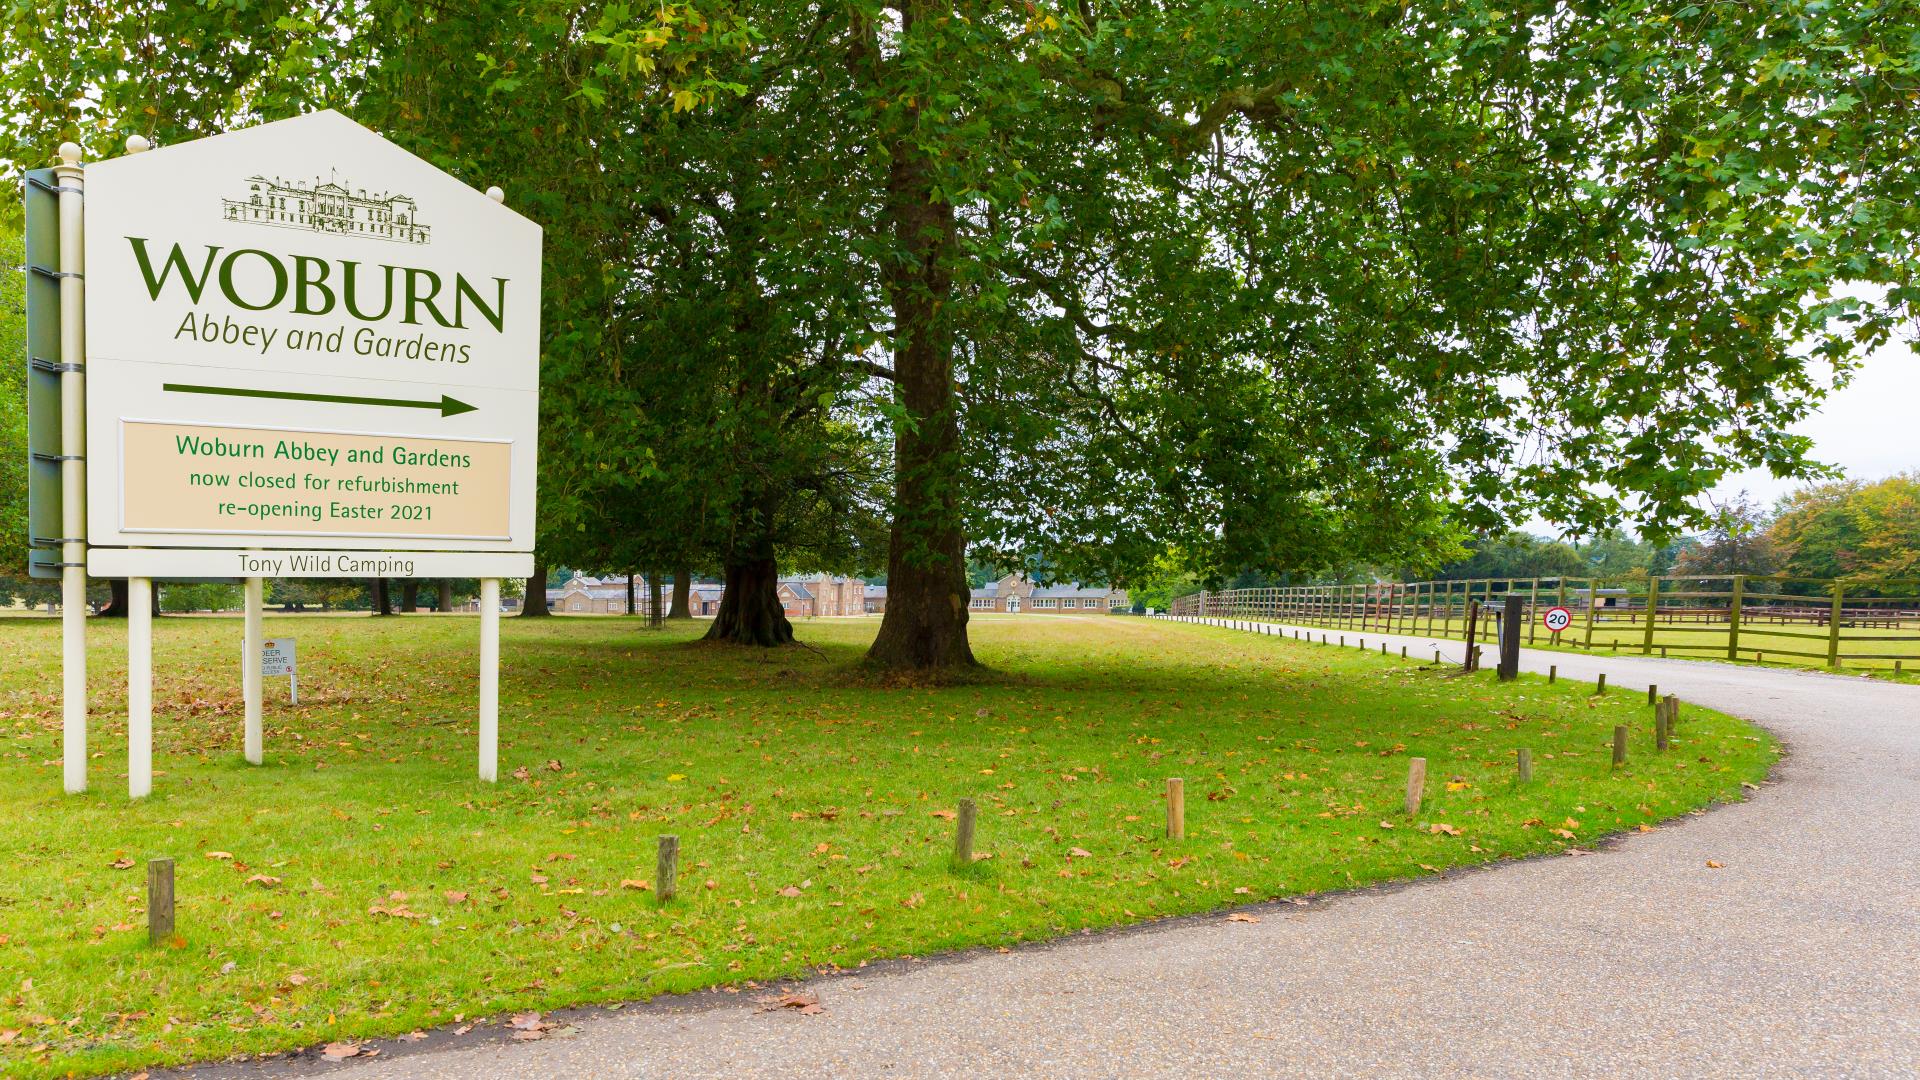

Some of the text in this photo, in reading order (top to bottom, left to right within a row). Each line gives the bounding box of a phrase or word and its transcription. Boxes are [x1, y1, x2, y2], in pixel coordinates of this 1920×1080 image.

[124, 237, 510, 334] WOBURN
[175, 311, 471, 364] Abbey and Gardens
[176, 435, 471, 469] Woburn Abbey and Gardens
[190, 471, 459, 496] now closed for refurbishment
[219, 500, 432, 521] re-opening Easter 2021
[239, 554, 415, 577] Tony Wild Camping
[1548, 614, 1566, 624] 20
[262, 656, 288, 664] SERVE
